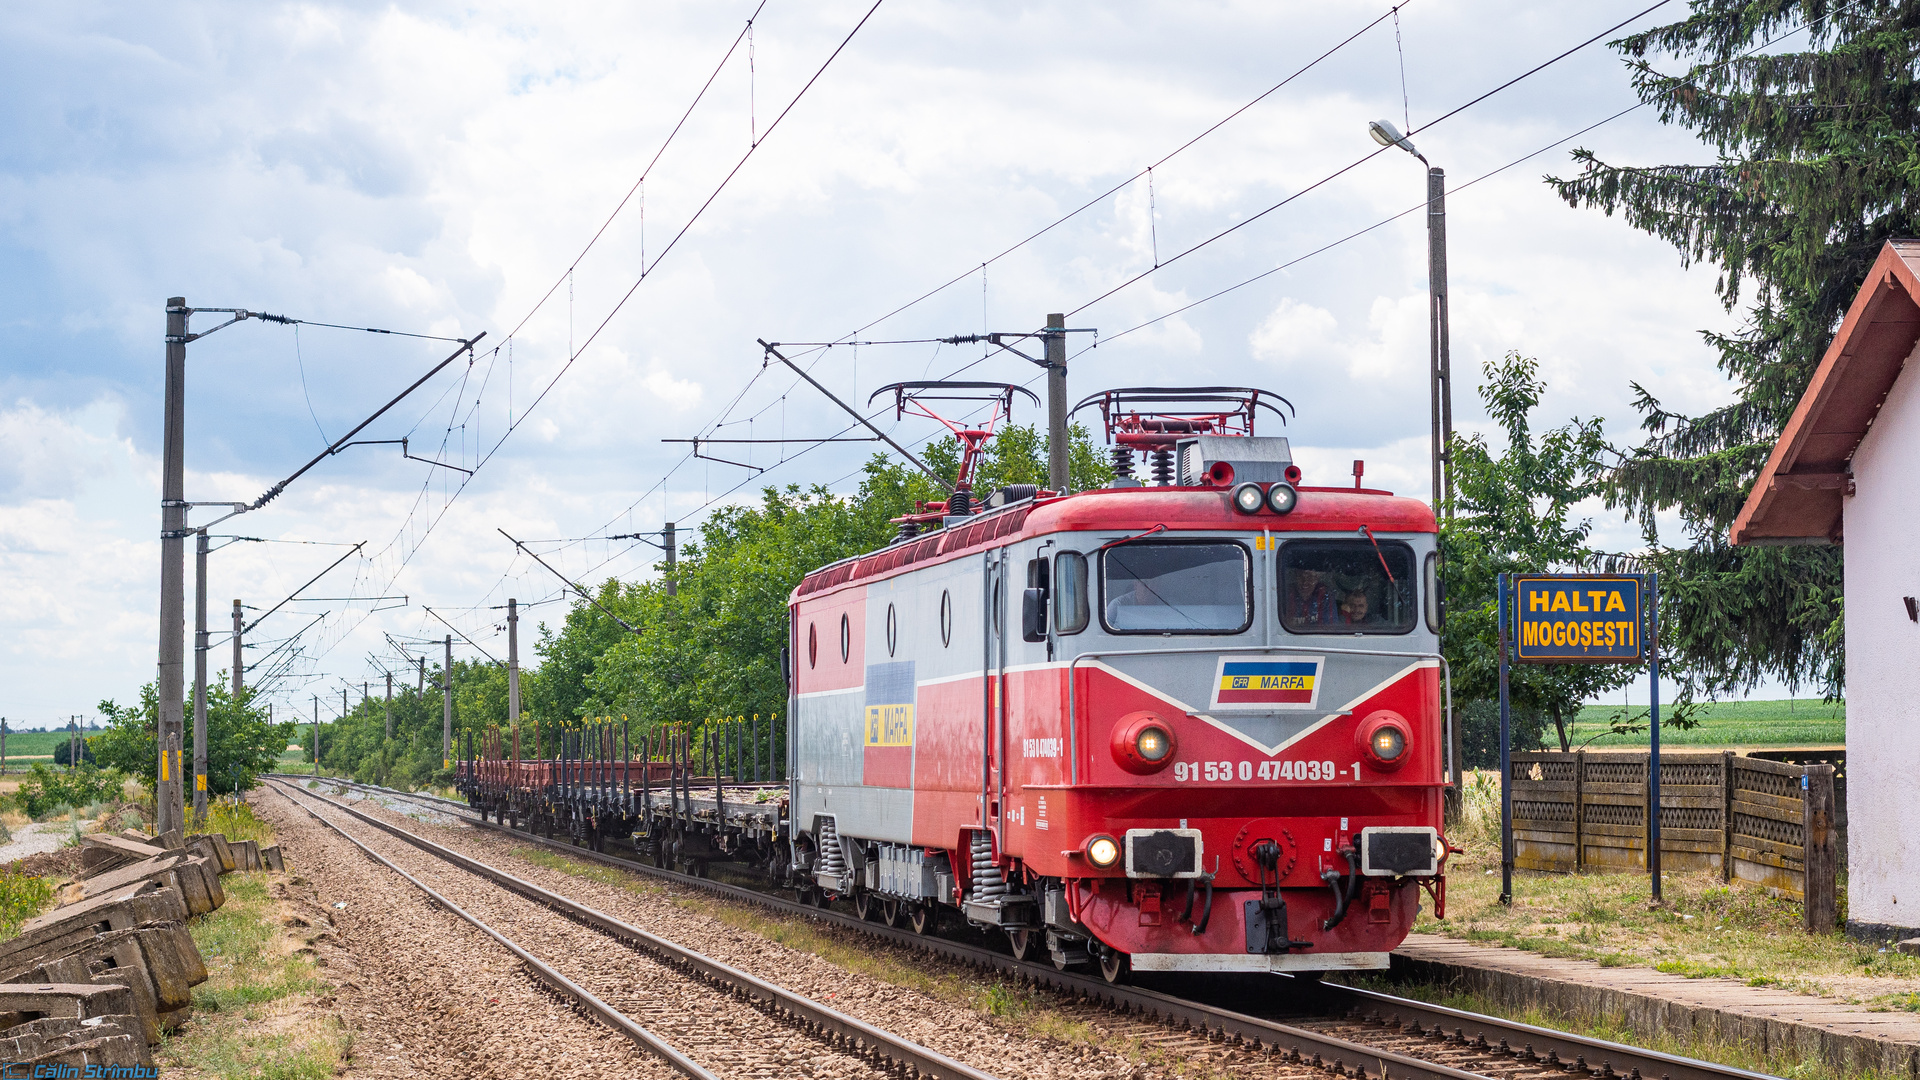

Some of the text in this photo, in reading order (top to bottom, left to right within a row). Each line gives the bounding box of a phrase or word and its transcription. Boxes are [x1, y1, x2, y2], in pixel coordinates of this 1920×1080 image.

[1529, 590, 1626, 612] HALTA
[1233, 676, 1305, 689] CFR MARFA
[883, 706, 908, 743] MARFA
[1174, 761, 1199, 781] 91
[1204, 761, 1233, 781] 53
[1238, 760, 1253, 781] 0
[1257, 760, 1335, 781] 474039
